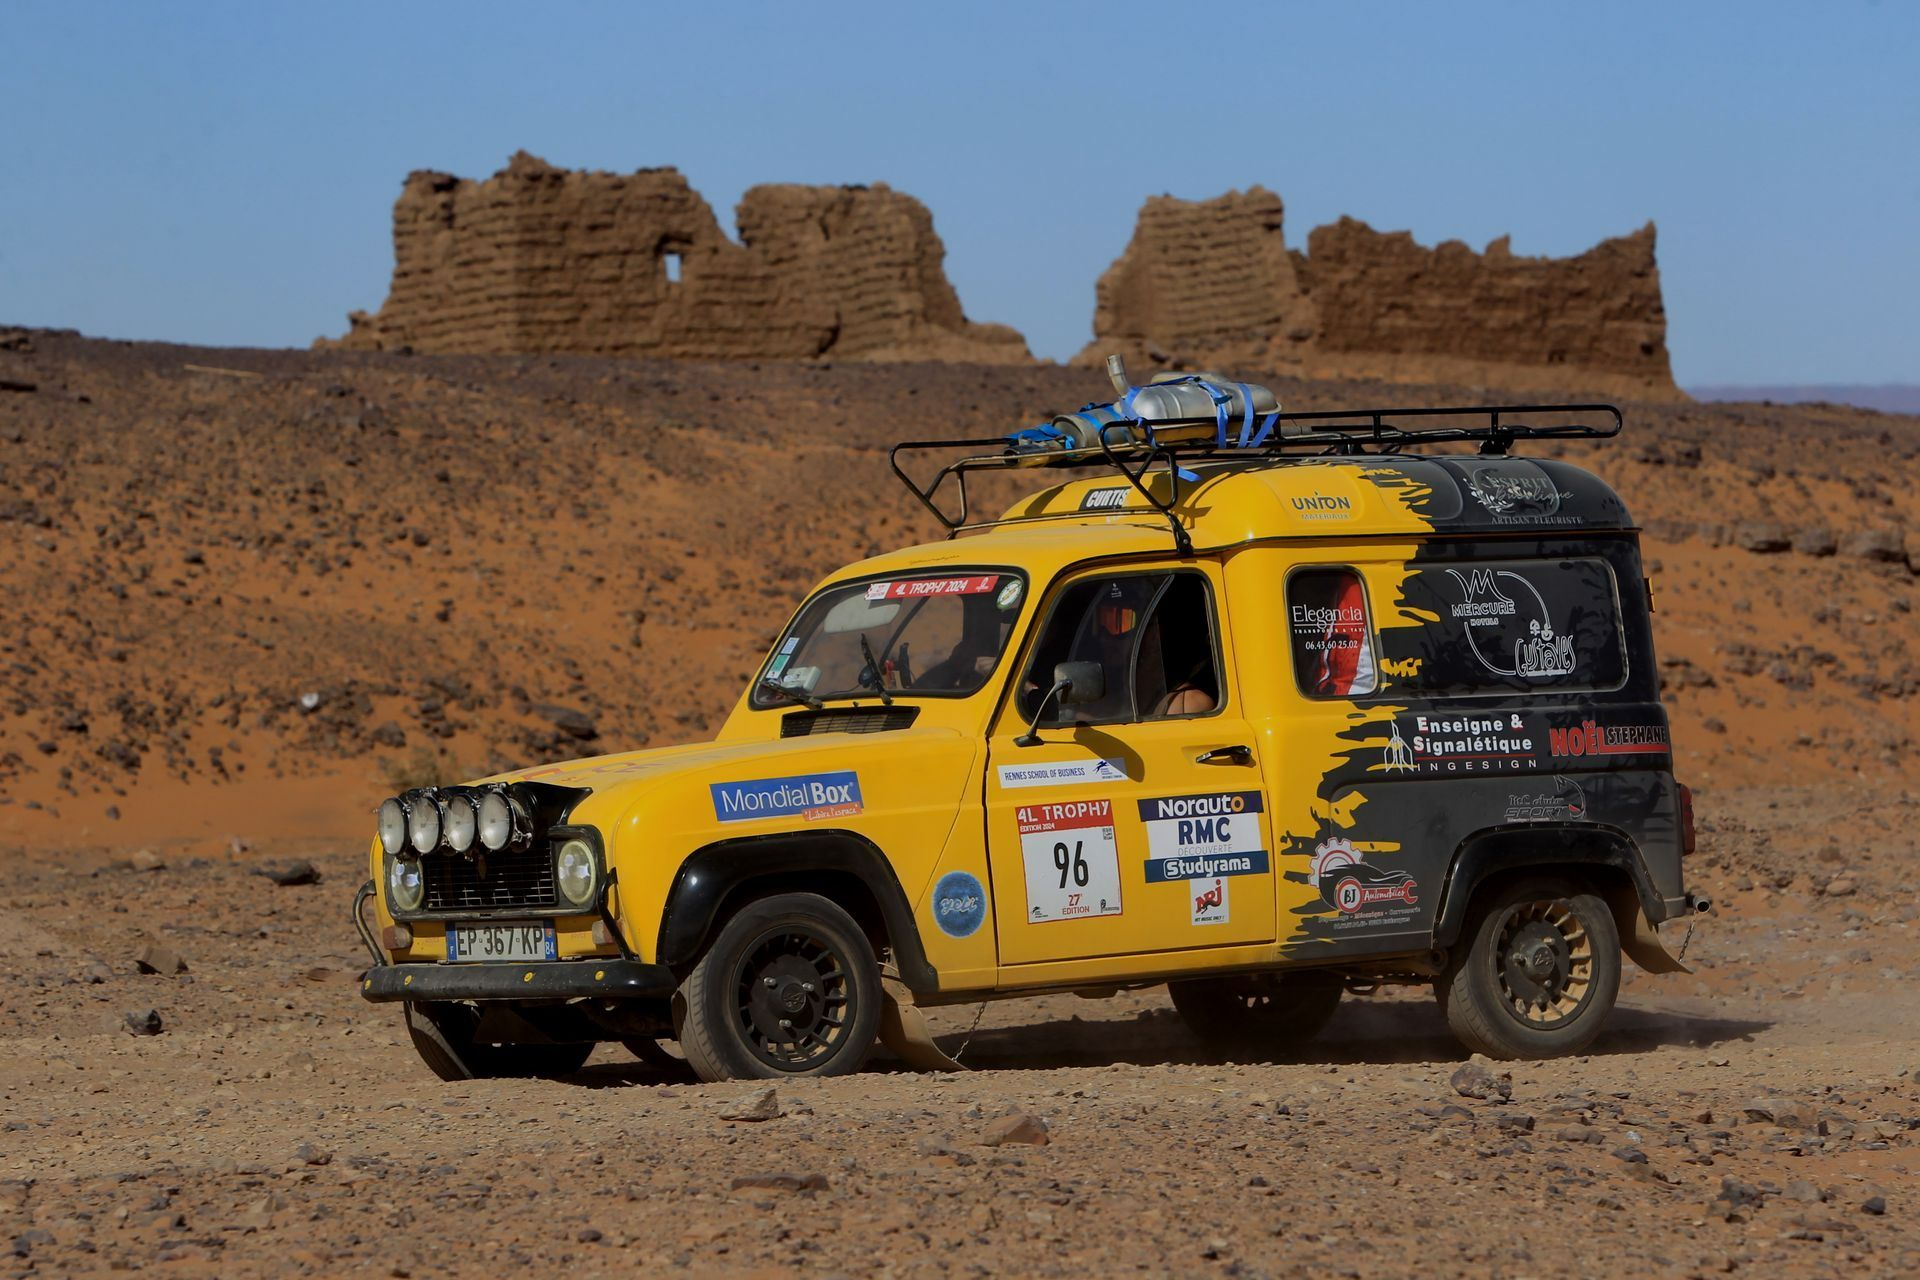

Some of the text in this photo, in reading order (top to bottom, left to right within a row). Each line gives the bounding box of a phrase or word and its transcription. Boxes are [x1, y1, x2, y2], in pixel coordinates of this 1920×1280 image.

[1086, 489, 1129, 507] CURTIS
[1491, 516, 1583, 525] ARTISAN FLEURISTE
[896, 584, 906, 595] 4L
[909, 582, 947, 595] TROPHY
[945, 580, 968, 592] 2024
[1292, 604, 1363, 629] Elegancia
[1451, 601, 1515, 617] MERCURE
[1470, 618, 1499, 626] HOTELS
[1305, 640, 1358, 650] 06.43.6025.02
[1416, 713, 1524, 735] Enseigne &
[1413, 736, 1533, 756] Signalétique
[1549, 720, 1606, 757] NOËL
[1005, 767, 1086, 781] RENNES SCHOOL OF BUSINESS
[721, 782, 853, 813] Mondial Box
[1158, 795, 1245, 818] Norauto
[1018, 800, 1110, 823] 4L TROPHY
[1042, 822, 1056, 831] 2024
[1178, 817, 1231, 846] RMC
[1178, 844, 1233, 857] DÉCOUVERTE
[1053, 840, 1090, 889] 96
[1164, 857, 1251, 878] Studyrama
[1344, 888, 1357, 905] BJ
[545, 941, 555, 955] 84
